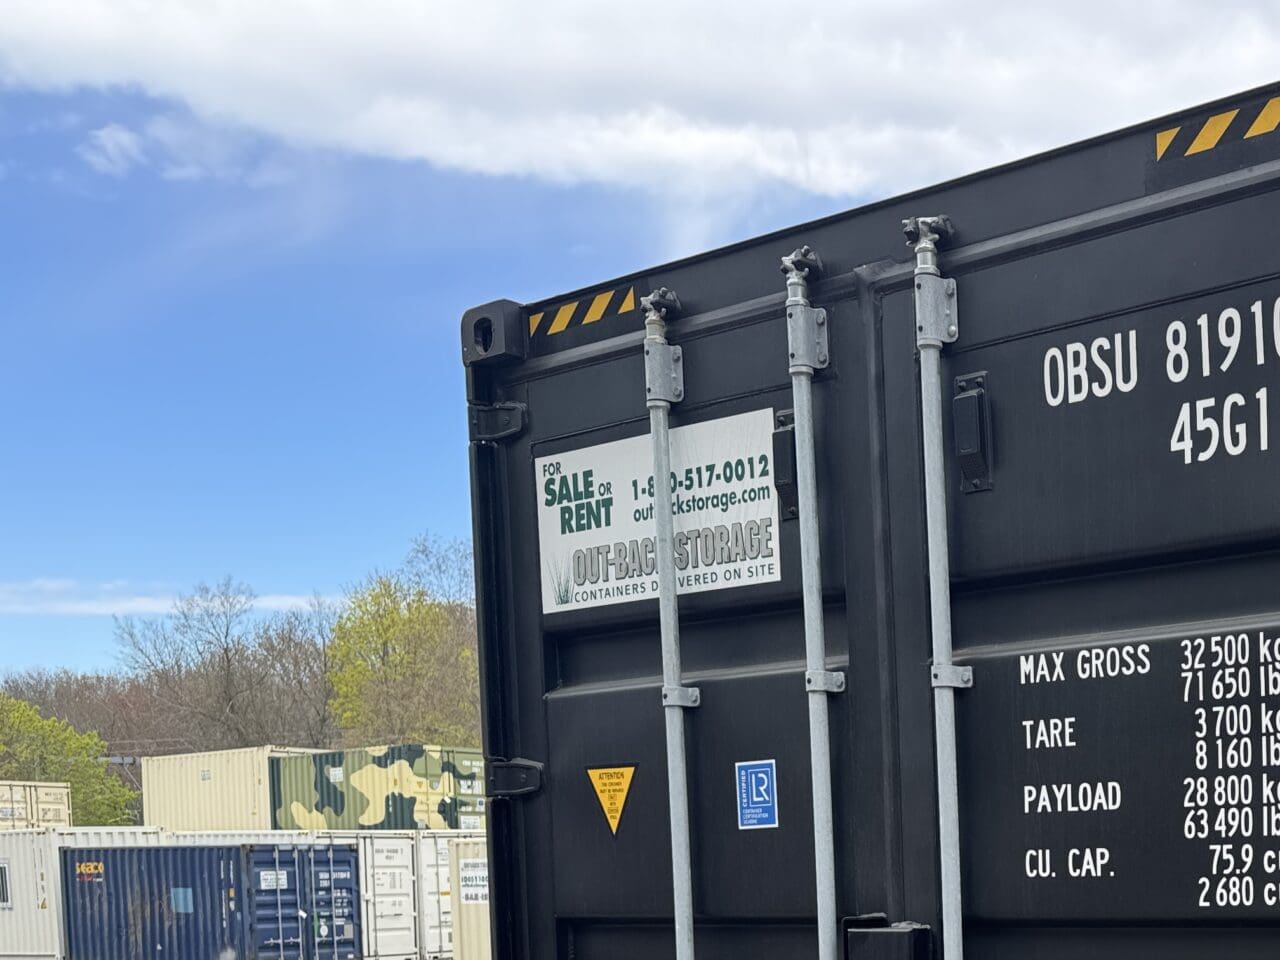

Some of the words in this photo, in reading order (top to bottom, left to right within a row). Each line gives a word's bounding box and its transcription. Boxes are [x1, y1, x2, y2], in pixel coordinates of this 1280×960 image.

[1043, 330, 1139, 407] OBSU
[1170, 387, 1269, 465] 45G1
[543, 462, 562, 477] FOR
[544, 469, 595, 507] SALE
[598, 482, 613, 497] OR
[631, 454, 770, 501] 1-80-517-0012
[560, 497, 614, 535] RENT
[633, 485, 770, 522] outckstorage.com
[674, 517, 774, 571] STORAGE
[574, 582, 647, 603] CONTAINERS
[651, 572, 719, 592] DVERED
[723, 568, 742, 582] ON
[747, 563, 775, 578] SITE
[1019, 652, 1065, 684] MAX
[1076, 644, 1151, 680] GROSS
[1022, 717, 1077, 749] TARE
[1024, 781, 1122, 813] PAYLOAD
[1025, 849, 1056, 877] CU.
[1068, 848, 1115, 877] CAP.
[1209, 844, 1254, 875] 75.9
